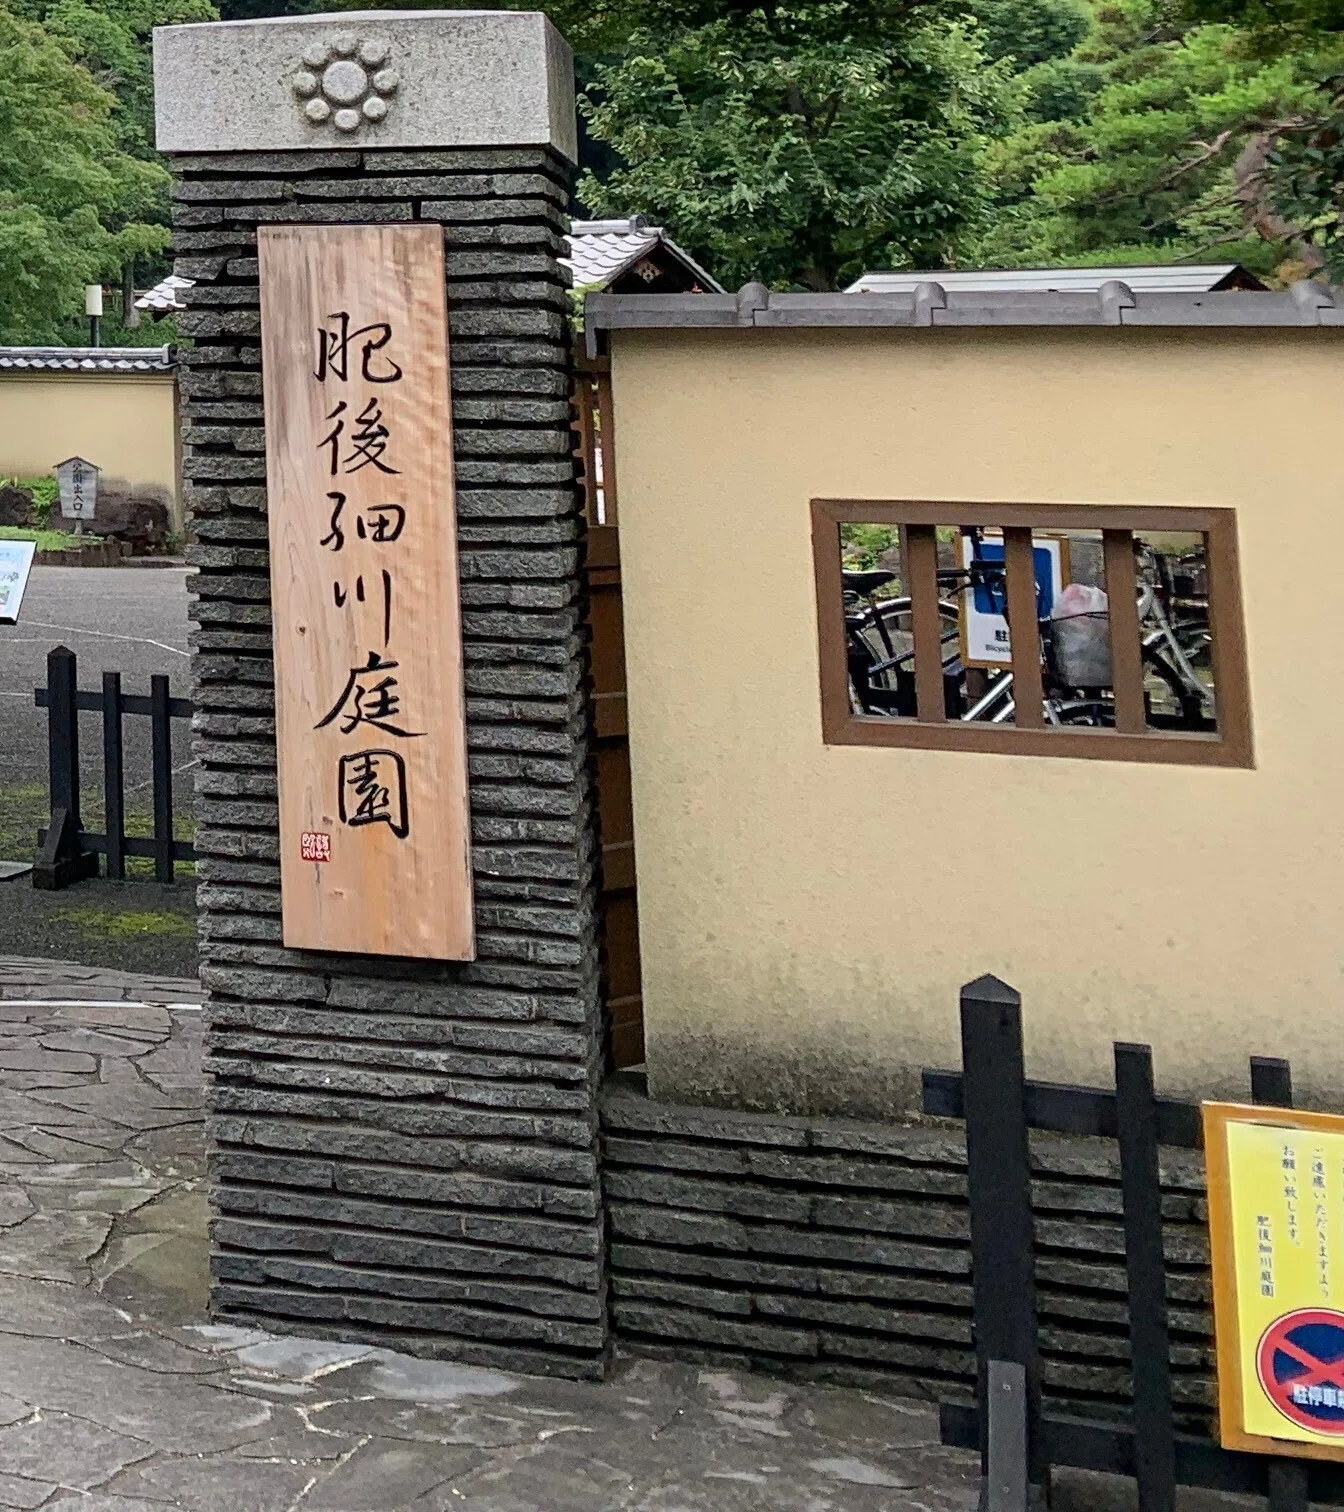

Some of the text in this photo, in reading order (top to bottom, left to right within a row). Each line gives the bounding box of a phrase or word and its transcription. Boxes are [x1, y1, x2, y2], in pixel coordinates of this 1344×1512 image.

[313, 311, 427, 840] 肥後細川庭園
